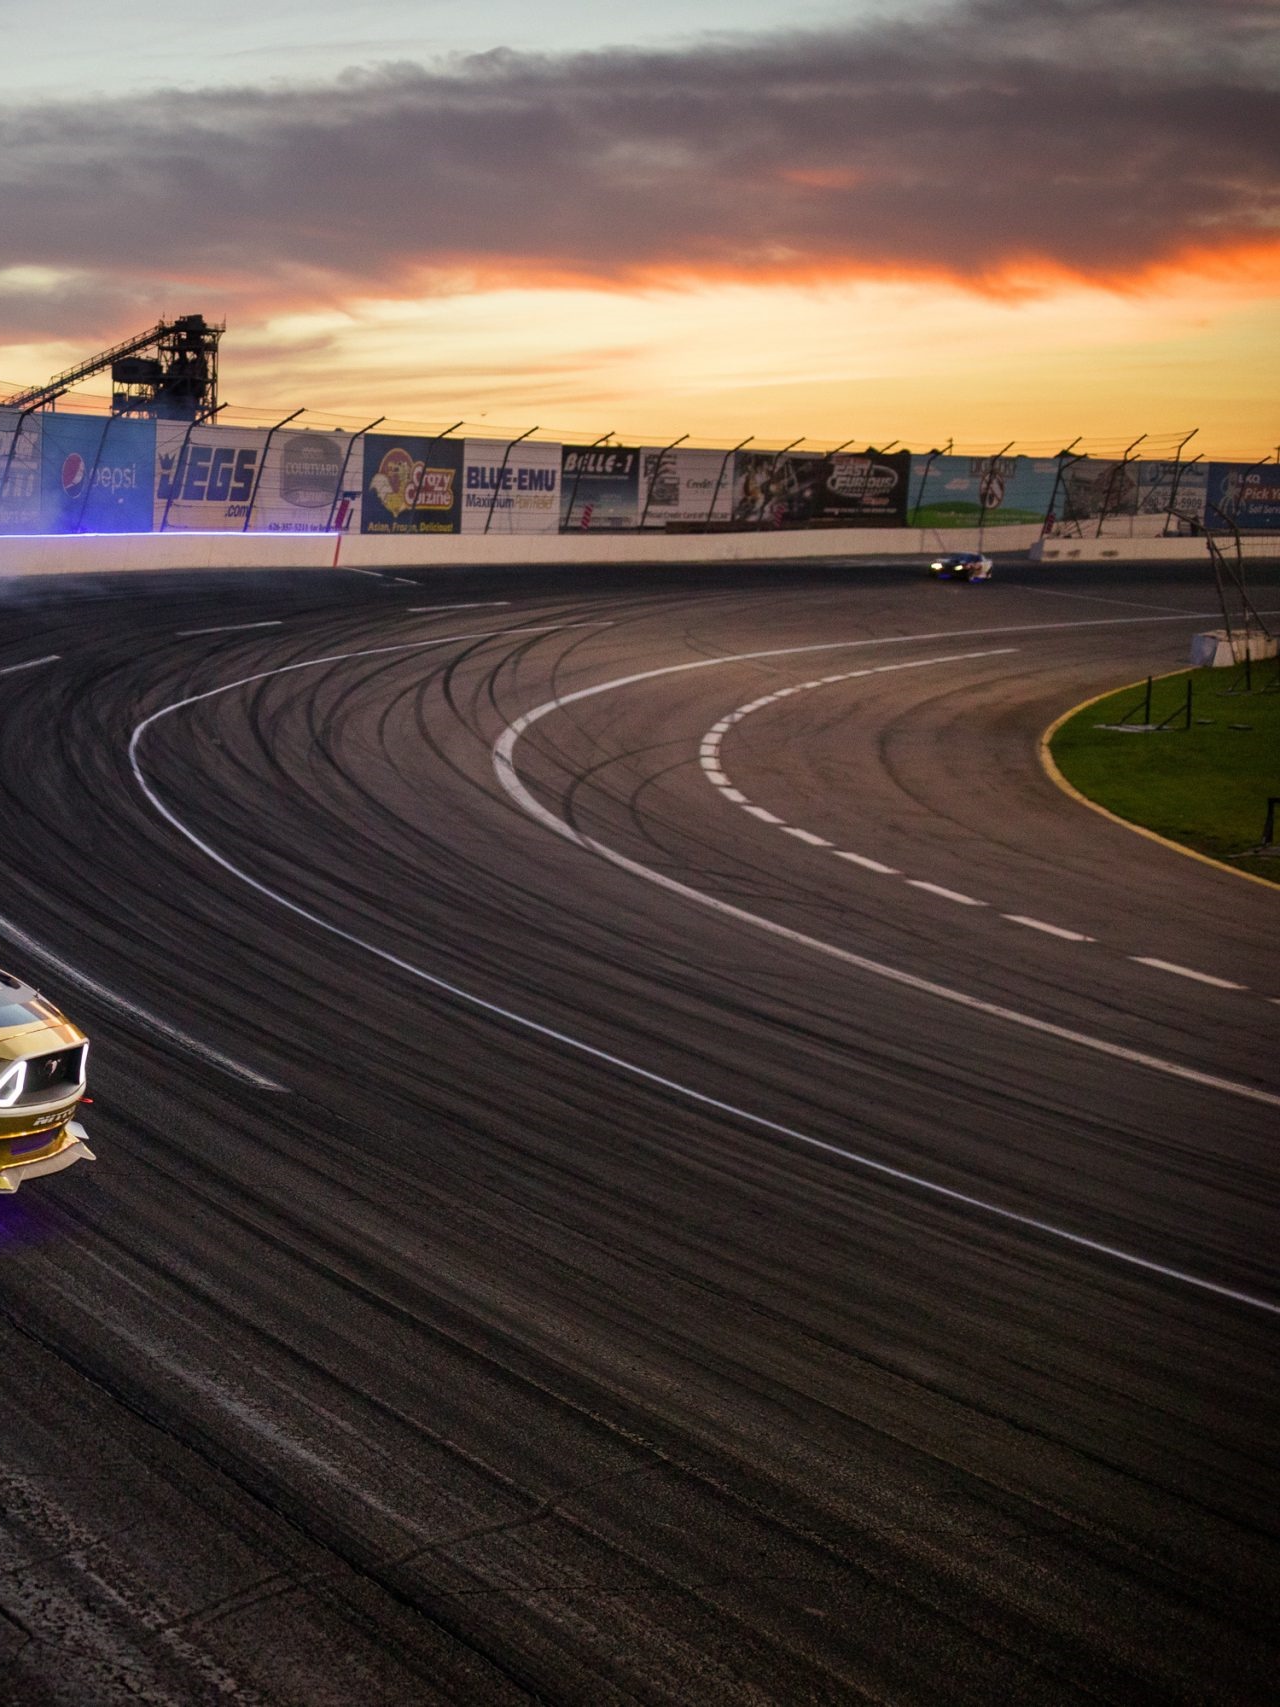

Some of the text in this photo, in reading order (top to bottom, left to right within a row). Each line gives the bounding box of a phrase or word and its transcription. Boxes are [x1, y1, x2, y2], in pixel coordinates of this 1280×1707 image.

[89, 462, 137, 495] pepsi
[157, 446, 258, 501] JEGS
[286, 462, 339, 476] COURTYARD
[412, 463, 451, 491] Crazy
[1244, 487, 1270, 500] Pick
